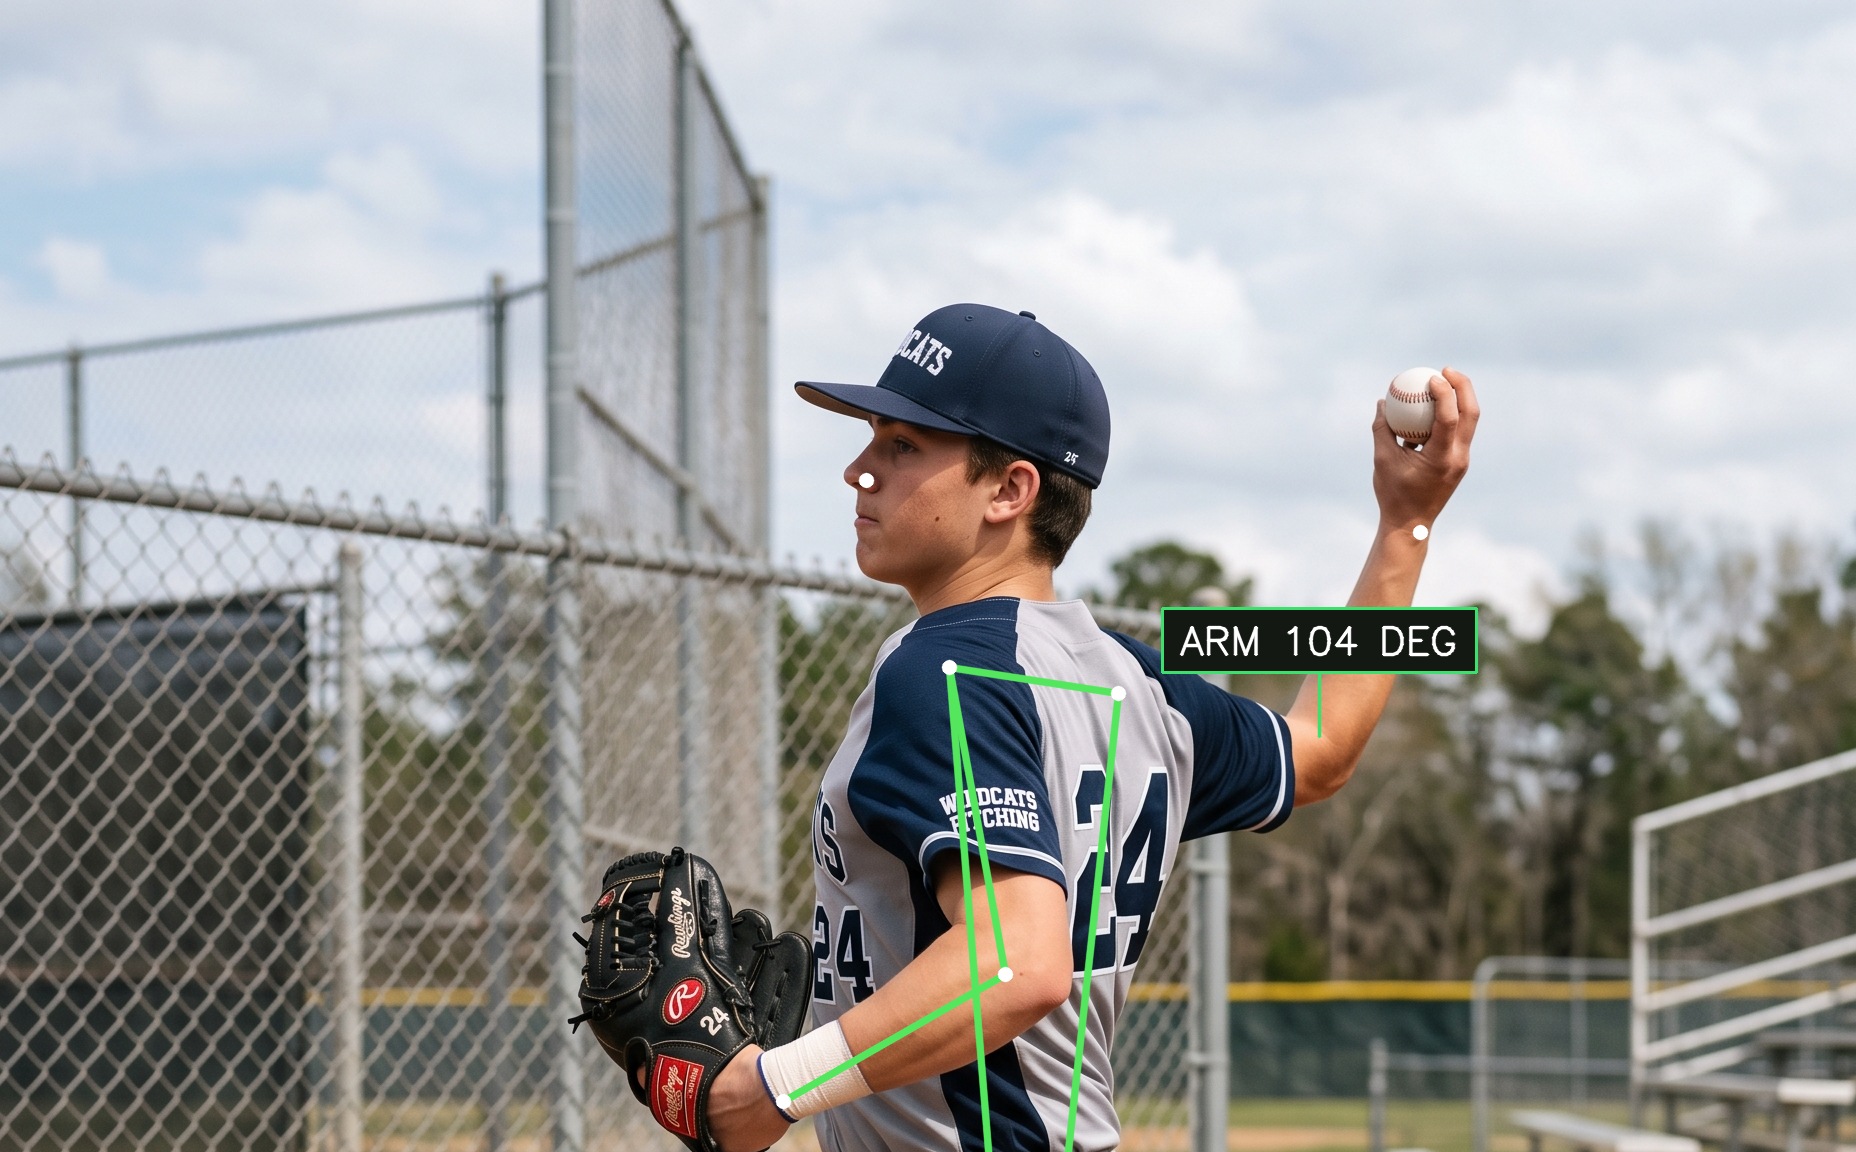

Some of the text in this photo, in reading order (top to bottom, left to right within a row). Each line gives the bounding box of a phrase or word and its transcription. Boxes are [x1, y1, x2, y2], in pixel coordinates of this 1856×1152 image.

[939, 787, 1038, 815] WDCATS
[1069, 764, 1166, 979] 24
[668, 887, 694, 958] Rawlings
[813, 901, 877, 1005] 24
[700, 1007, 730, 1036] 24
